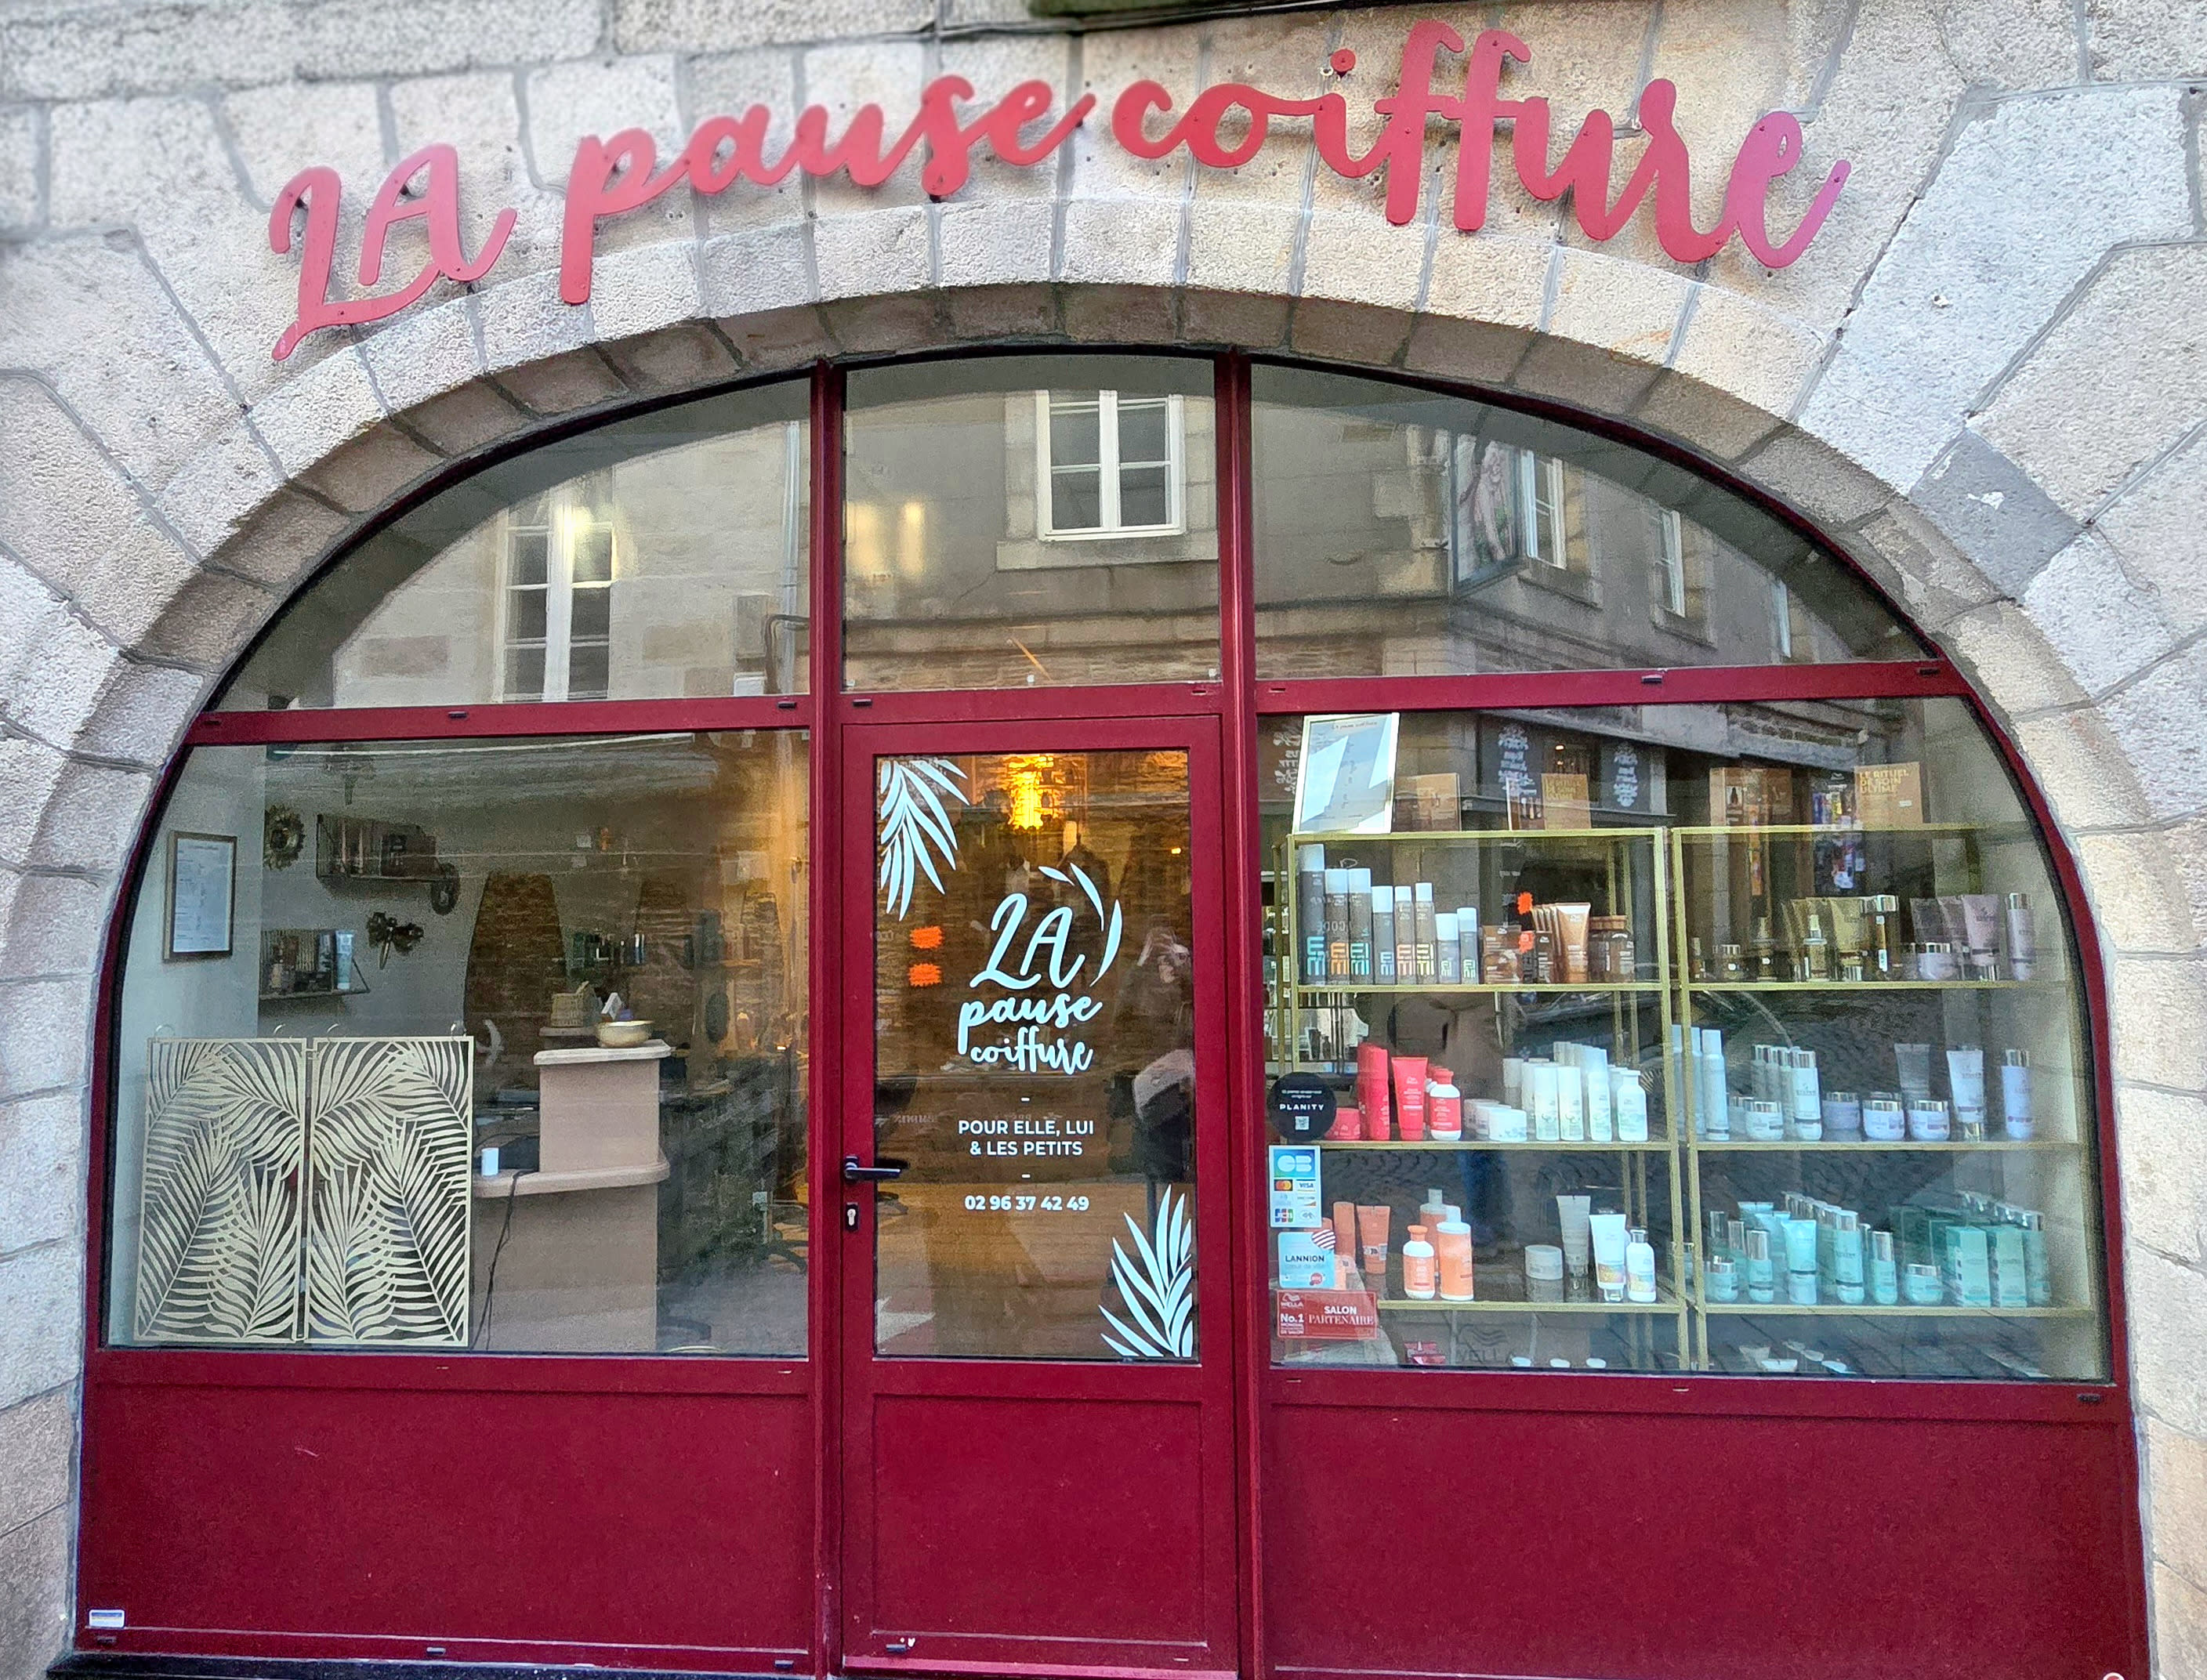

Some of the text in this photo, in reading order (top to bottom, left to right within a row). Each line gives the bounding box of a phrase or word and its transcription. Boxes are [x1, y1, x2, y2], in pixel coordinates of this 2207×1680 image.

[270, 20, 1851, 360] LA pause coiffure
[969, 893, 1085, 990] LA
[958, 993, 1103, 1055] pause
[969, 1025, 1093, 1075] coiffure
[959, 1121, 1093, 1137] POUR ELLE, LUI
[969, 1142, 1082, 1156] & LES PETITS
[965, 1196, 1089, 1211] 02 96 37 42 49
[1324, 1305, 1357, 1315] SALON
[1280, 1313, 1304, 1323] No.1
[1308, 1313, 1374, 1325] PARTENAIRE
